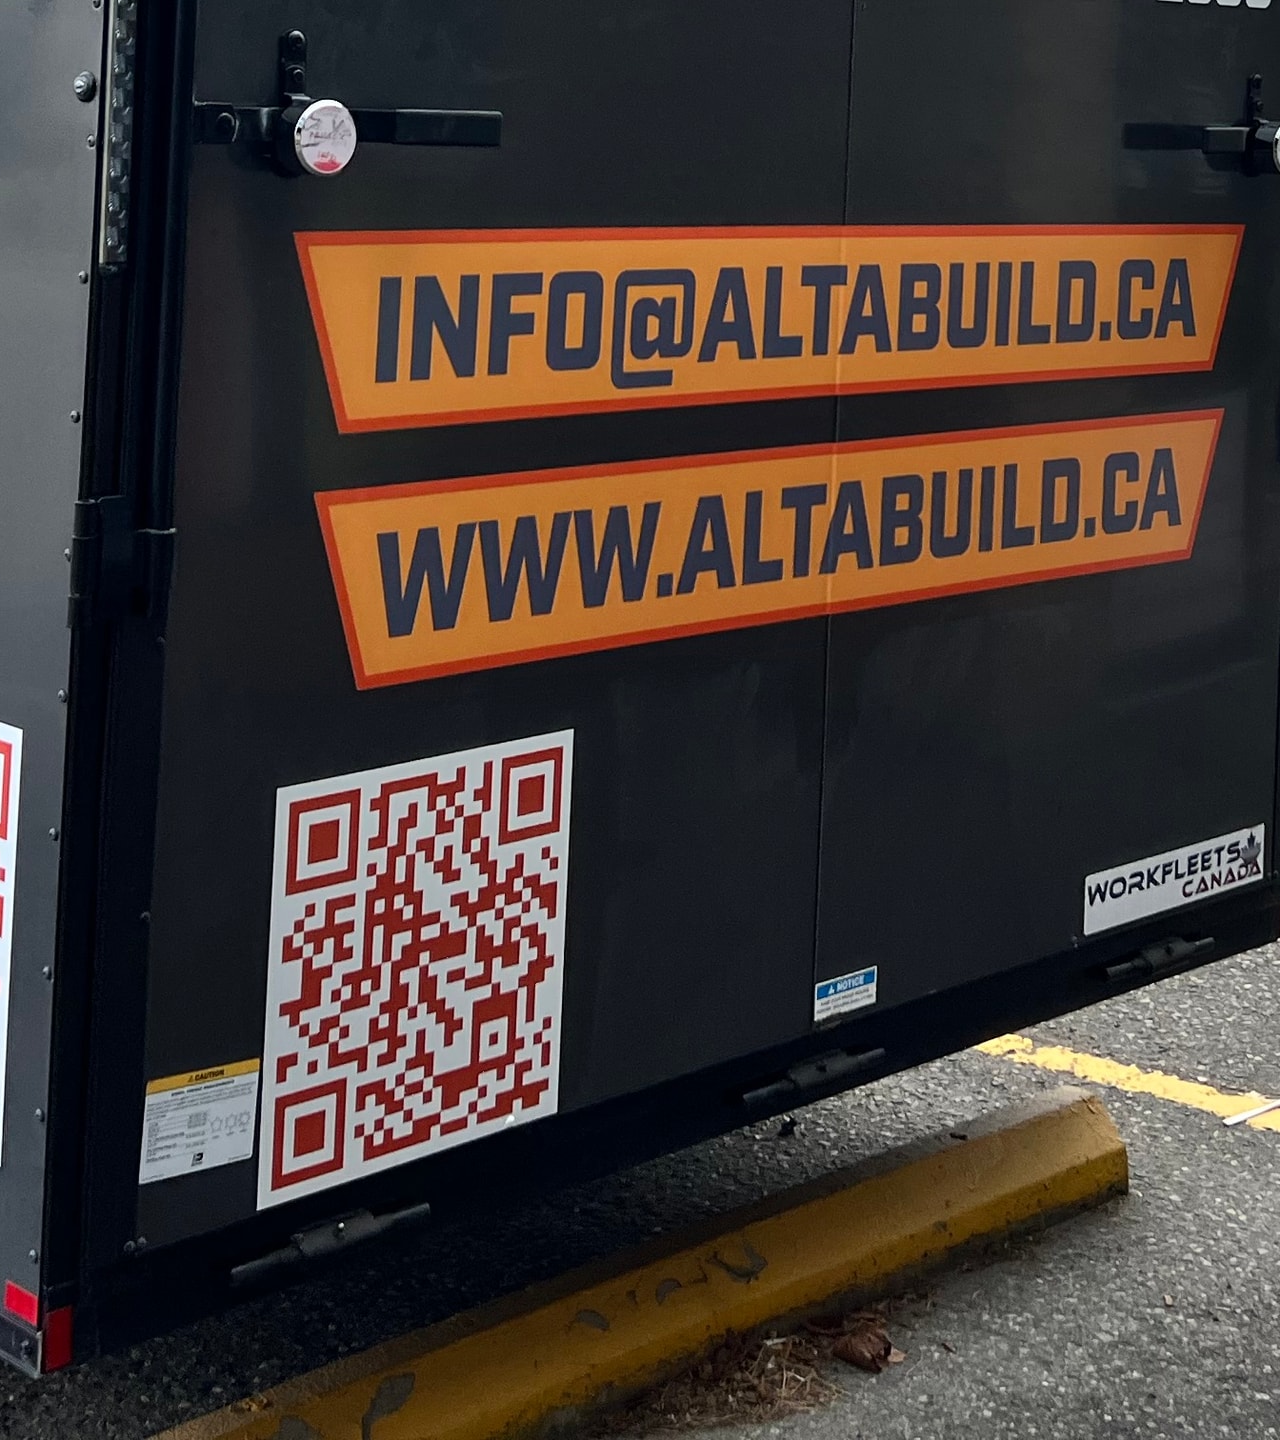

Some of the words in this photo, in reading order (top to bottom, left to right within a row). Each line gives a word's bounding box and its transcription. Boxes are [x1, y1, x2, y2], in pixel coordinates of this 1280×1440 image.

[373, 257, 1197, 390] INFO@ALTABUILD.CA
[375, 447, 1182, 639] WWW.ALTABUILD.CA
[1088, 840, 1241, 907] WORKFLEETS
[1182, 860, 1261, 898] CANADA
[194, 1069, 225, 1081] CAUTION
